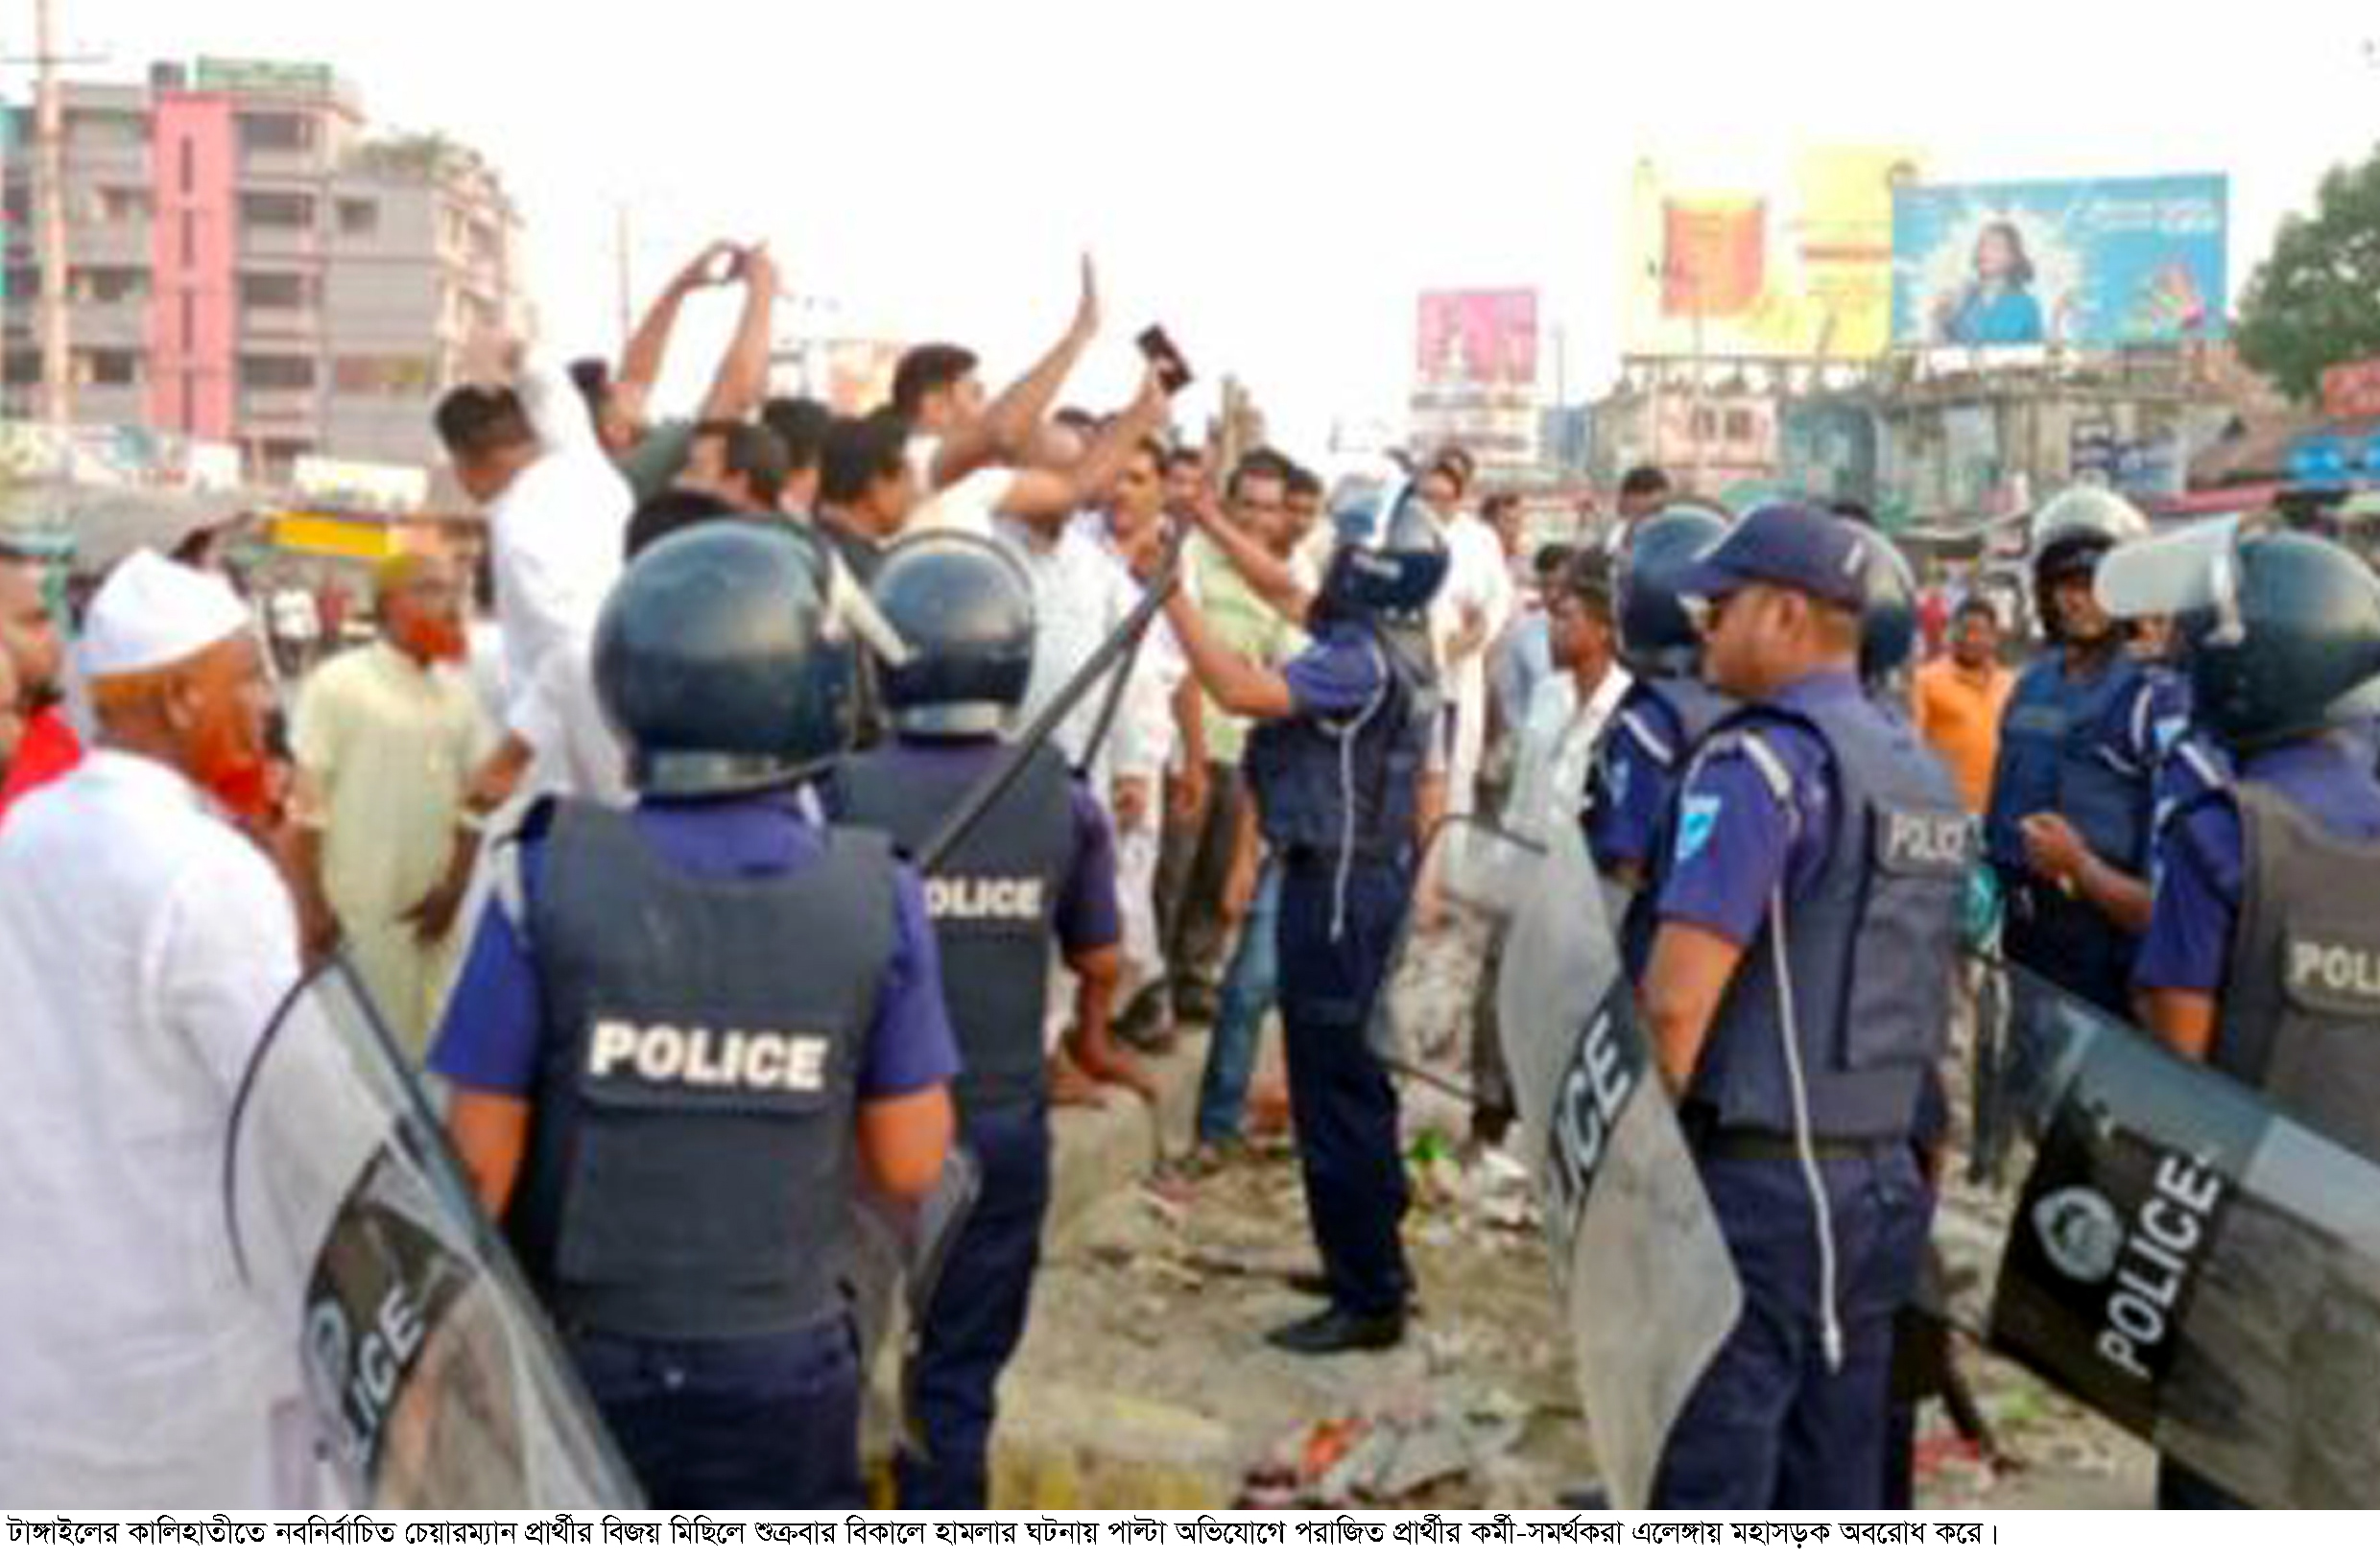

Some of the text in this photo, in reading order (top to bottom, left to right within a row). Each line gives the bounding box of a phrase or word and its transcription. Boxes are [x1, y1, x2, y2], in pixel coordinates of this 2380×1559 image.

[924, 877, 1044, 918] OLICE
[589, 1021, 827, 1090] POLICE
[2095, 1154, 2221, 1382] POLICE
